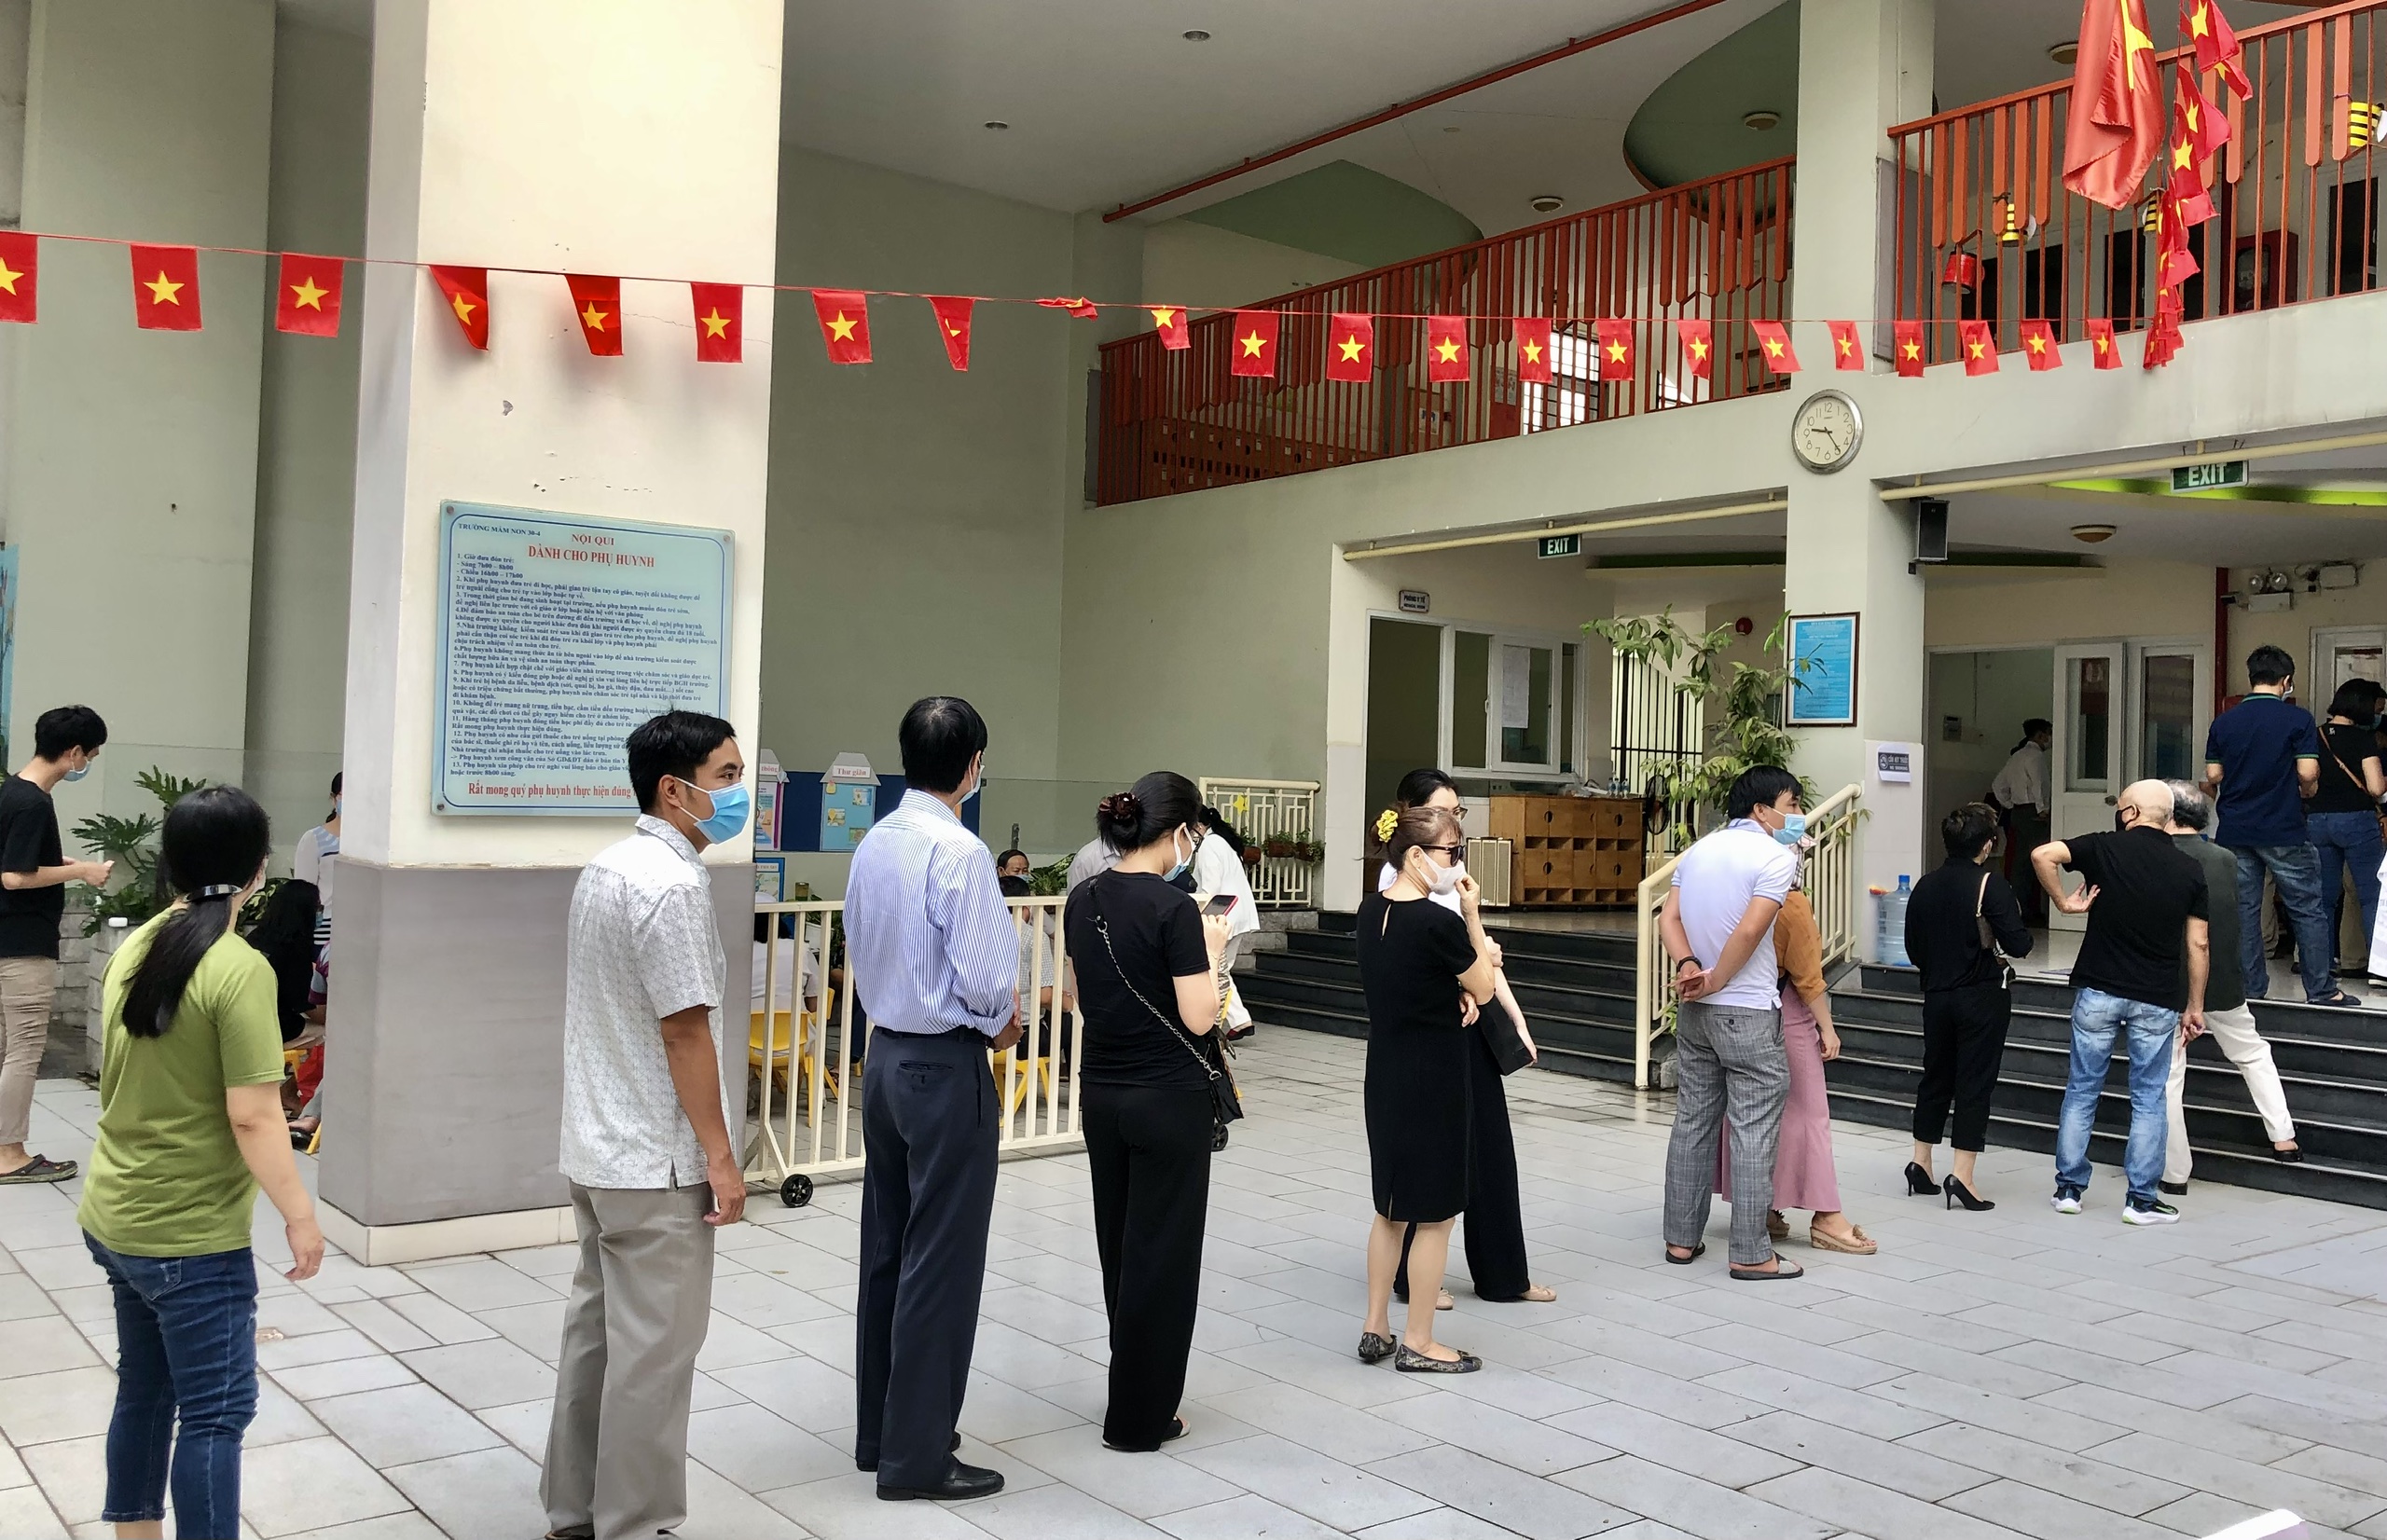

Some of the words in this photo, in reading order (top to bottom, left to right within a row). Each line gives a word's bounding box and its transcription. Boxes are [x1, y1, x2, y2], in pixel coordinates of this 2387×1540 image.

[1815, 407, 1822, 418] 11
[1825, 402, 1833, 413] 12
[1807, 416, 1815, 426] 10
[1843, 412, 1849, 422] 2
[1803, 428, 1810, 438] 9
[1846, 423, 1853, 434] 3
[1806, 440, 1813, 449] 8
[1843, 436, 1849, 446] 4
[1815, 447, 1821, 457] 7
[1824, 450, 1831, 461] 6
[1834, 445, 1842, 455] 5
[2188, 462, 2228, 487] EXIT
[572, 533, 592, 545] NỘI
[595, 535, 614, 546] QUI
[1547, 537, 1570, 555] EXIT
[529, 543, 560, 560] DÀNH
[563, 548, 588, 562] CHO
[591, 551, 614, 567] PHỤ
[616, 553, 655, 568] HUYNH
[468, 779, 484, 794] Rất
[486, 786, 508, 797] mong
[511, 783, 526, 798] quý
[528, 784, 544, 798] phụ
[546, 784, 571, 798] huynh
[573, 784, 591, 799] thực
[593, 785, 610, 799] hiện
[612, 785, 631, 798] đúng
